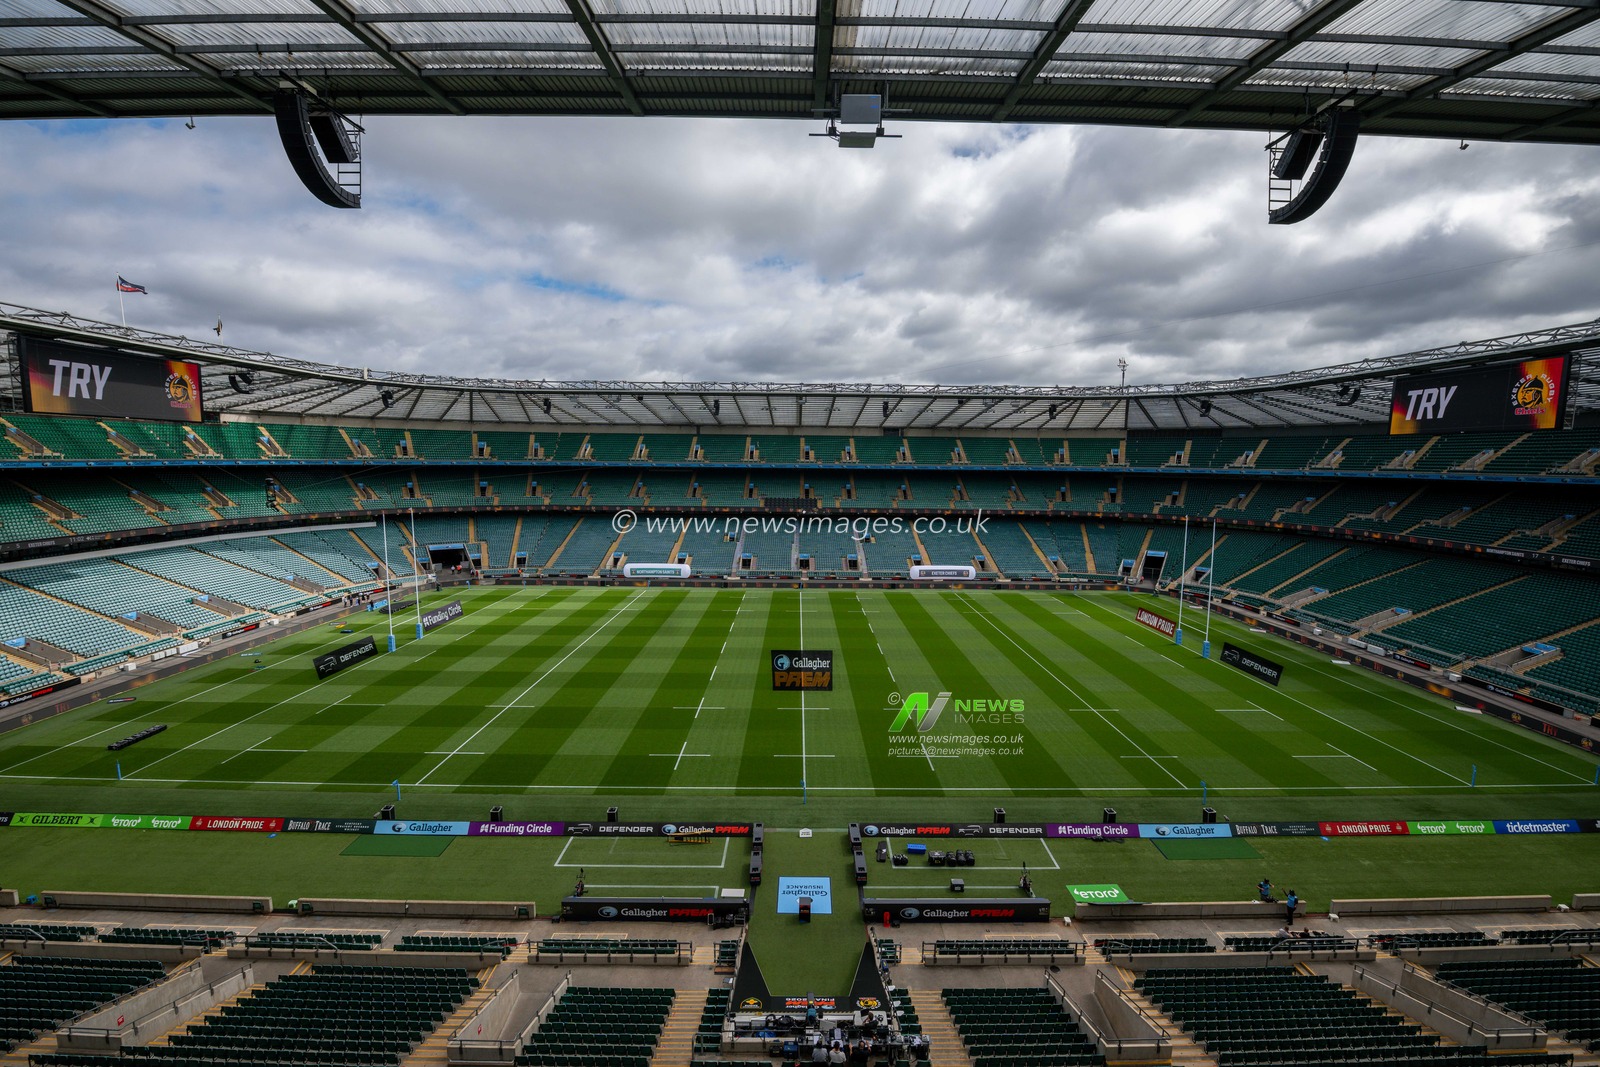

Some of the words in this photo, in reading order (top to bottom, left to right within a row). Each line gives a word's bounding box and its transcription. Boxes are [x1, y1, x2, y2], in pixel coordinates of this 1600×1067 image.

[49, 359, 112, 400] TRY
[1405, 385, 1458, 421] TRY
[428, 609, 449, 625] Funding
[448, 603, 462, 617] Circle
[1138, 609, 1157, 627] LONDON
[1157, 618, 1176, 635] PRIDE
[340, 643, 374, 663] DEFENDER
[792, 657, 830, 670] Gallagher
[1241, 657, 1278, 679] DEFENDER
[31, 815, 82, 825] GILBERT
[207, 819, 240, 829] LONDON
[240, 820, 264, 829] PRIDE
[409, 822, 453, 834] Gallagher
[489, 823, 524, 835] Funding
[526, 823, 552, 833] Circle
[880, 826, 916, 836] Gallagher
[1067, 825, 1101, 836] Funding
[1103, 825, 1129, 835] Circle
[1172, 826, 1215, 836] Gallagher
[1261, 824, 1278, 835] TRACE
[1336, 824, 1368, 834] LONDON
[1369, 824, 1392, 833] PRIDE
[1506, 822, 1567, 833] ticketmaster
[782, 889, 828, 897] Gallagher
[620, 907, 667, 918] Gallagher
[922, 909, 969, 919] Gallagher
